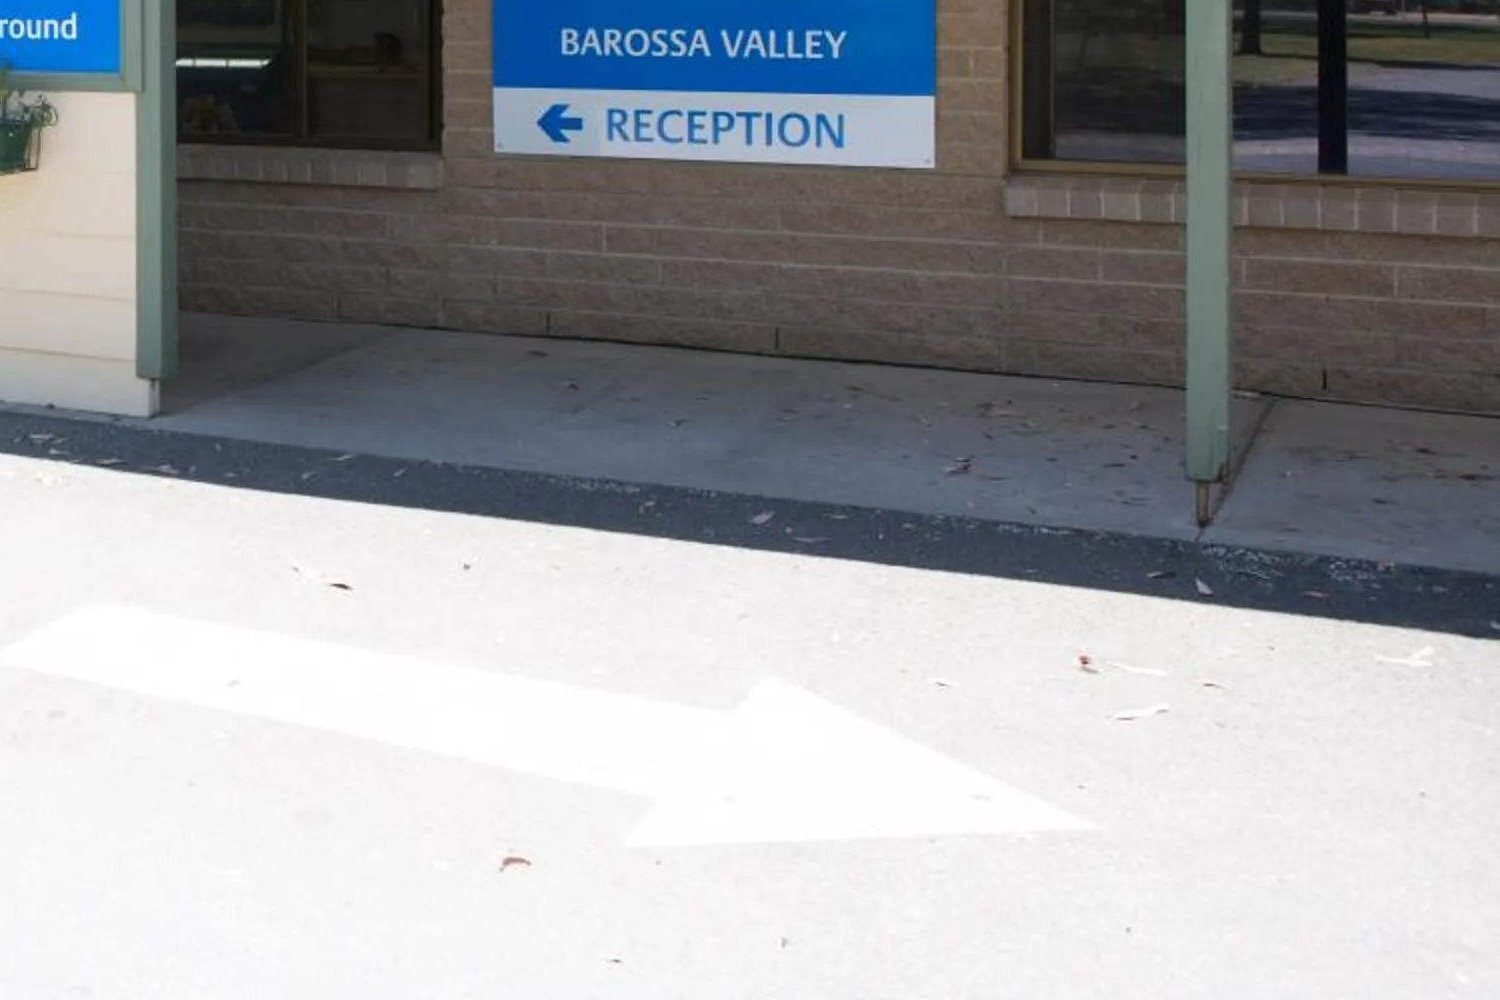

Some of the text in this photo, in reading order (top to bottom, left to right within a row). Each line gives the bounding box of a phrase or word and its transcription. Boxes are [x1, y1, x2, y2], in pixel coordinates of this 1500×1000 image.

[561, 27, 848, 60] BAROSSA VALLEY
[605, 107, 846, 149] RECEPTION
